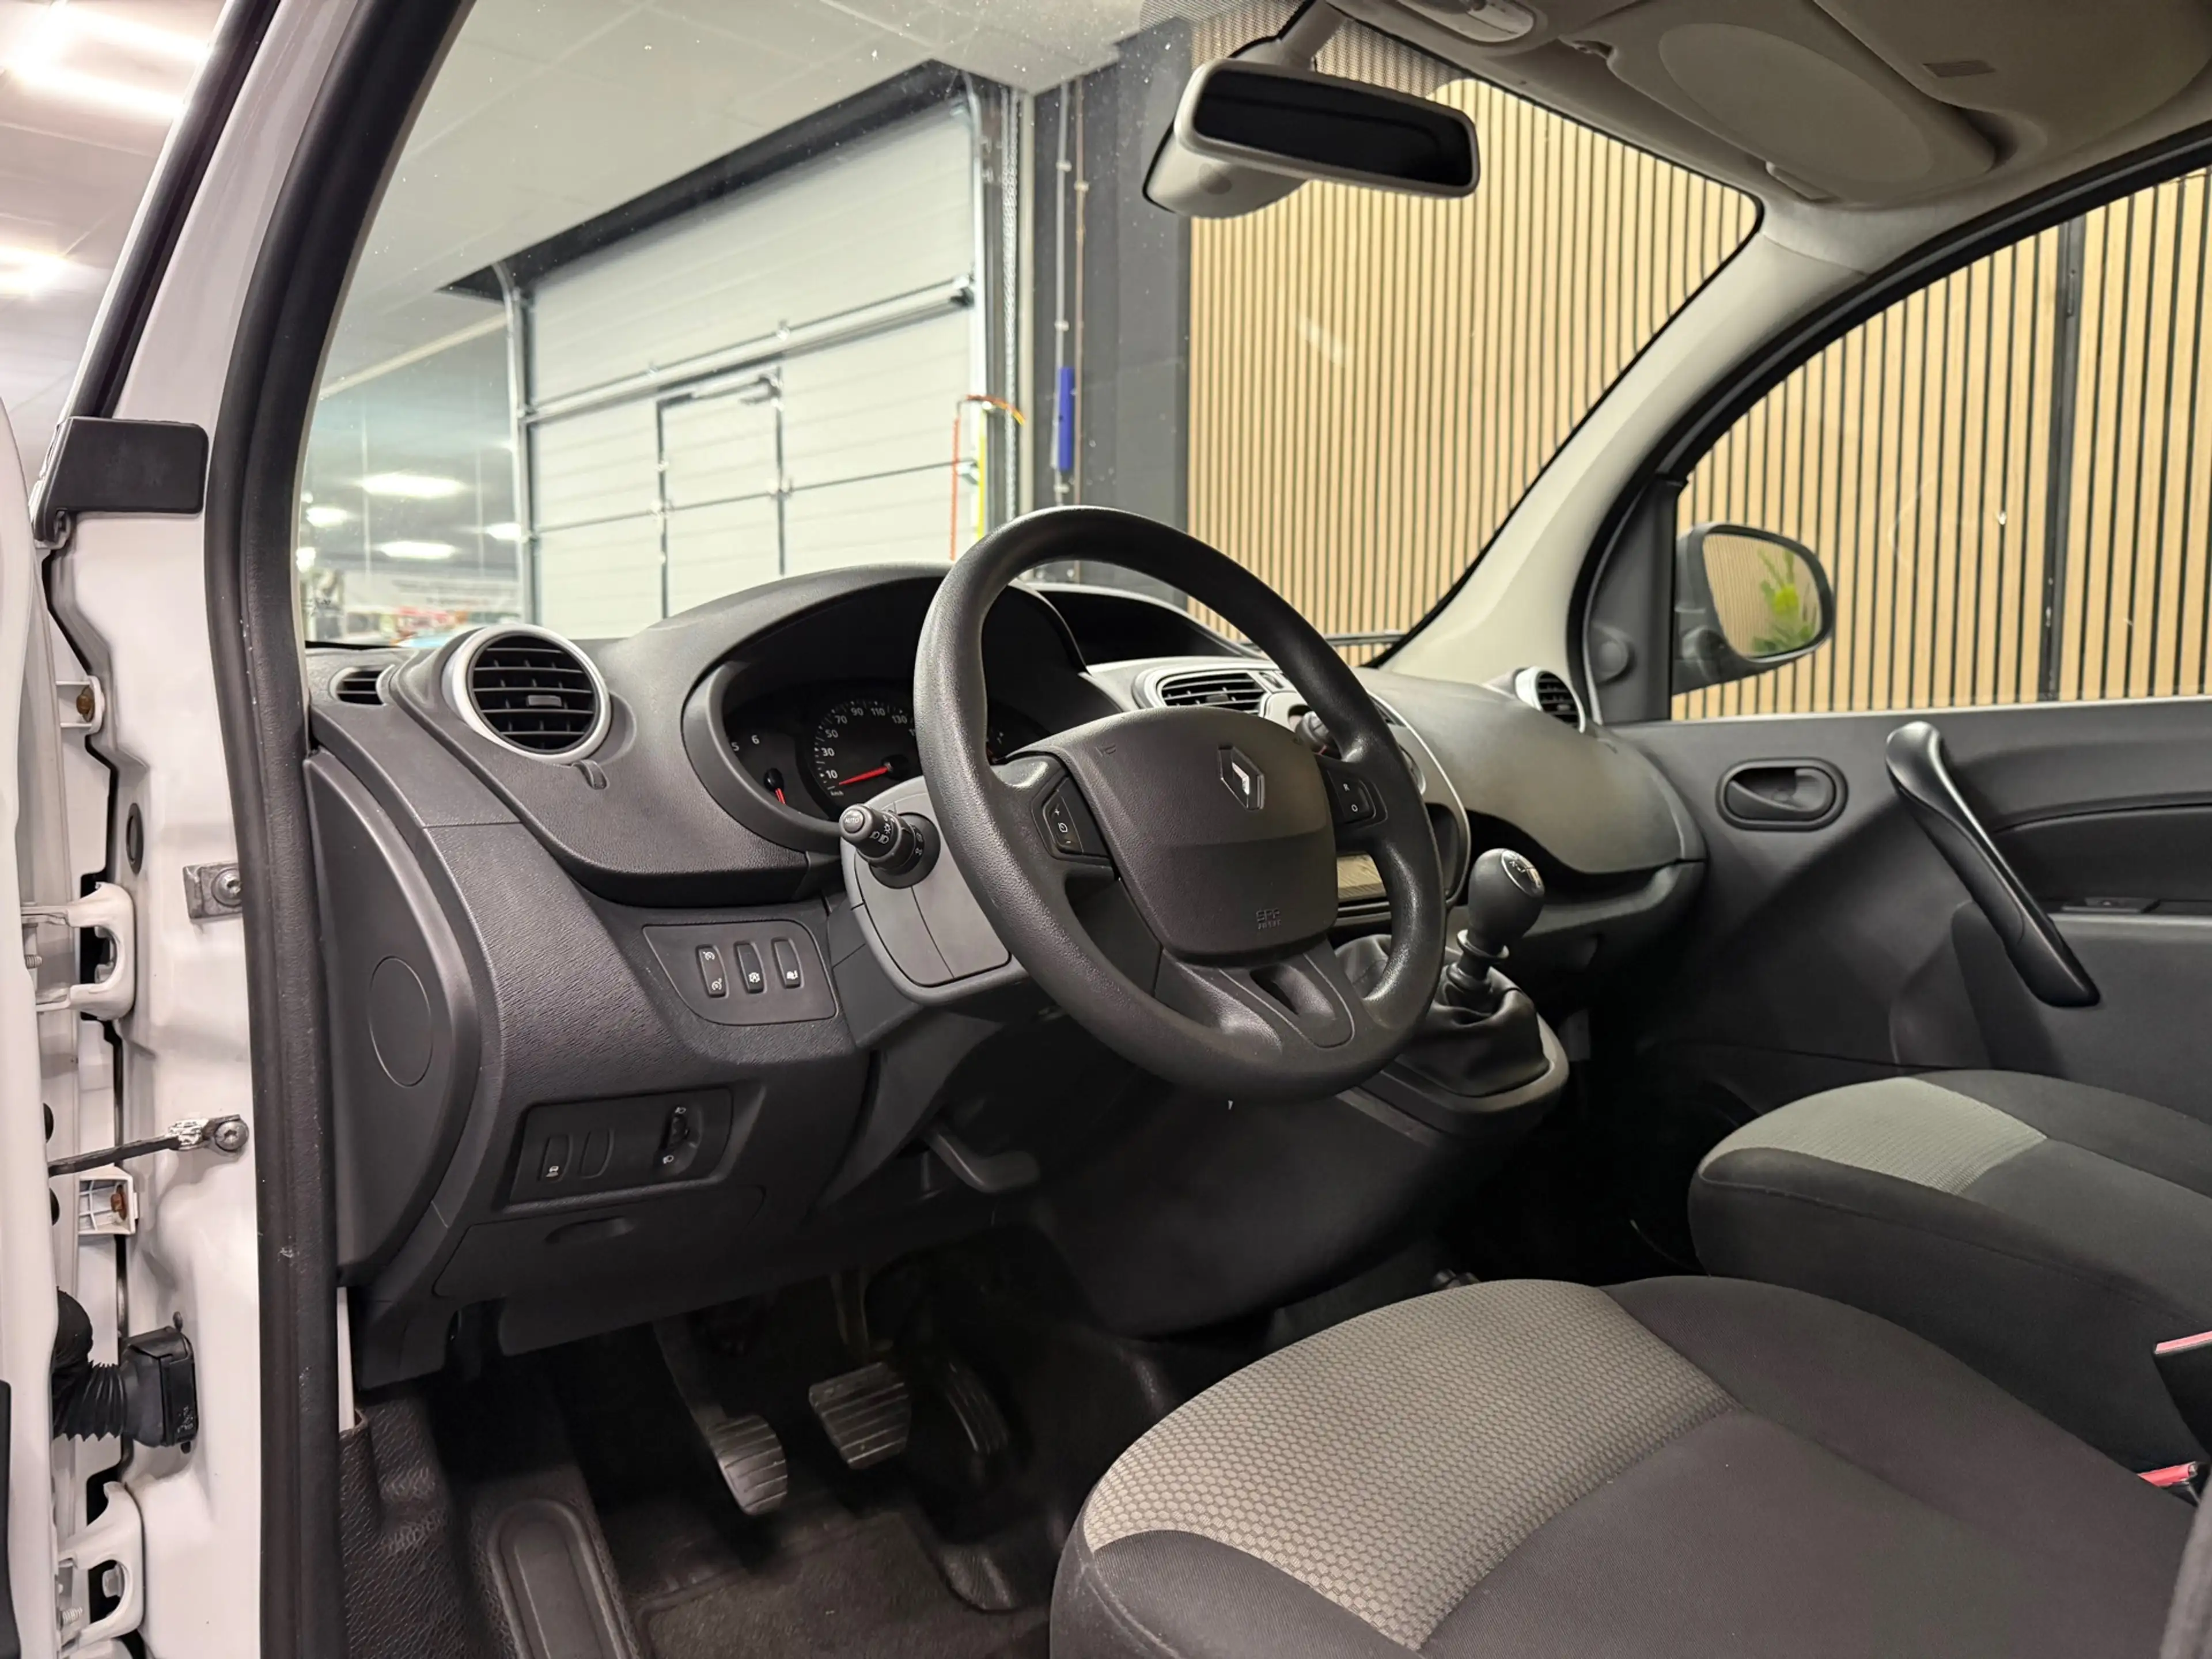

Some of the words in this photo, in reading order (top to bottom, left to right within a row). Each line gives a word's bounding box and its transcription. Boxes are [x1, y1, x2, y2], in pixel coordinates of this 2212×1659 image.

[850, 707, 863, 716] 90
[870, 708, 885, 716] 110
[835, 715, 847, 724] 70
[892, 715, 907, 724] 130
[825, 729, 838, 738] 50
[751, 735, 760, 744] 6
[731, 742, 739, 751] 5
[821, 748, 835, 756] 30
[825, 770, 838, 779] 10
